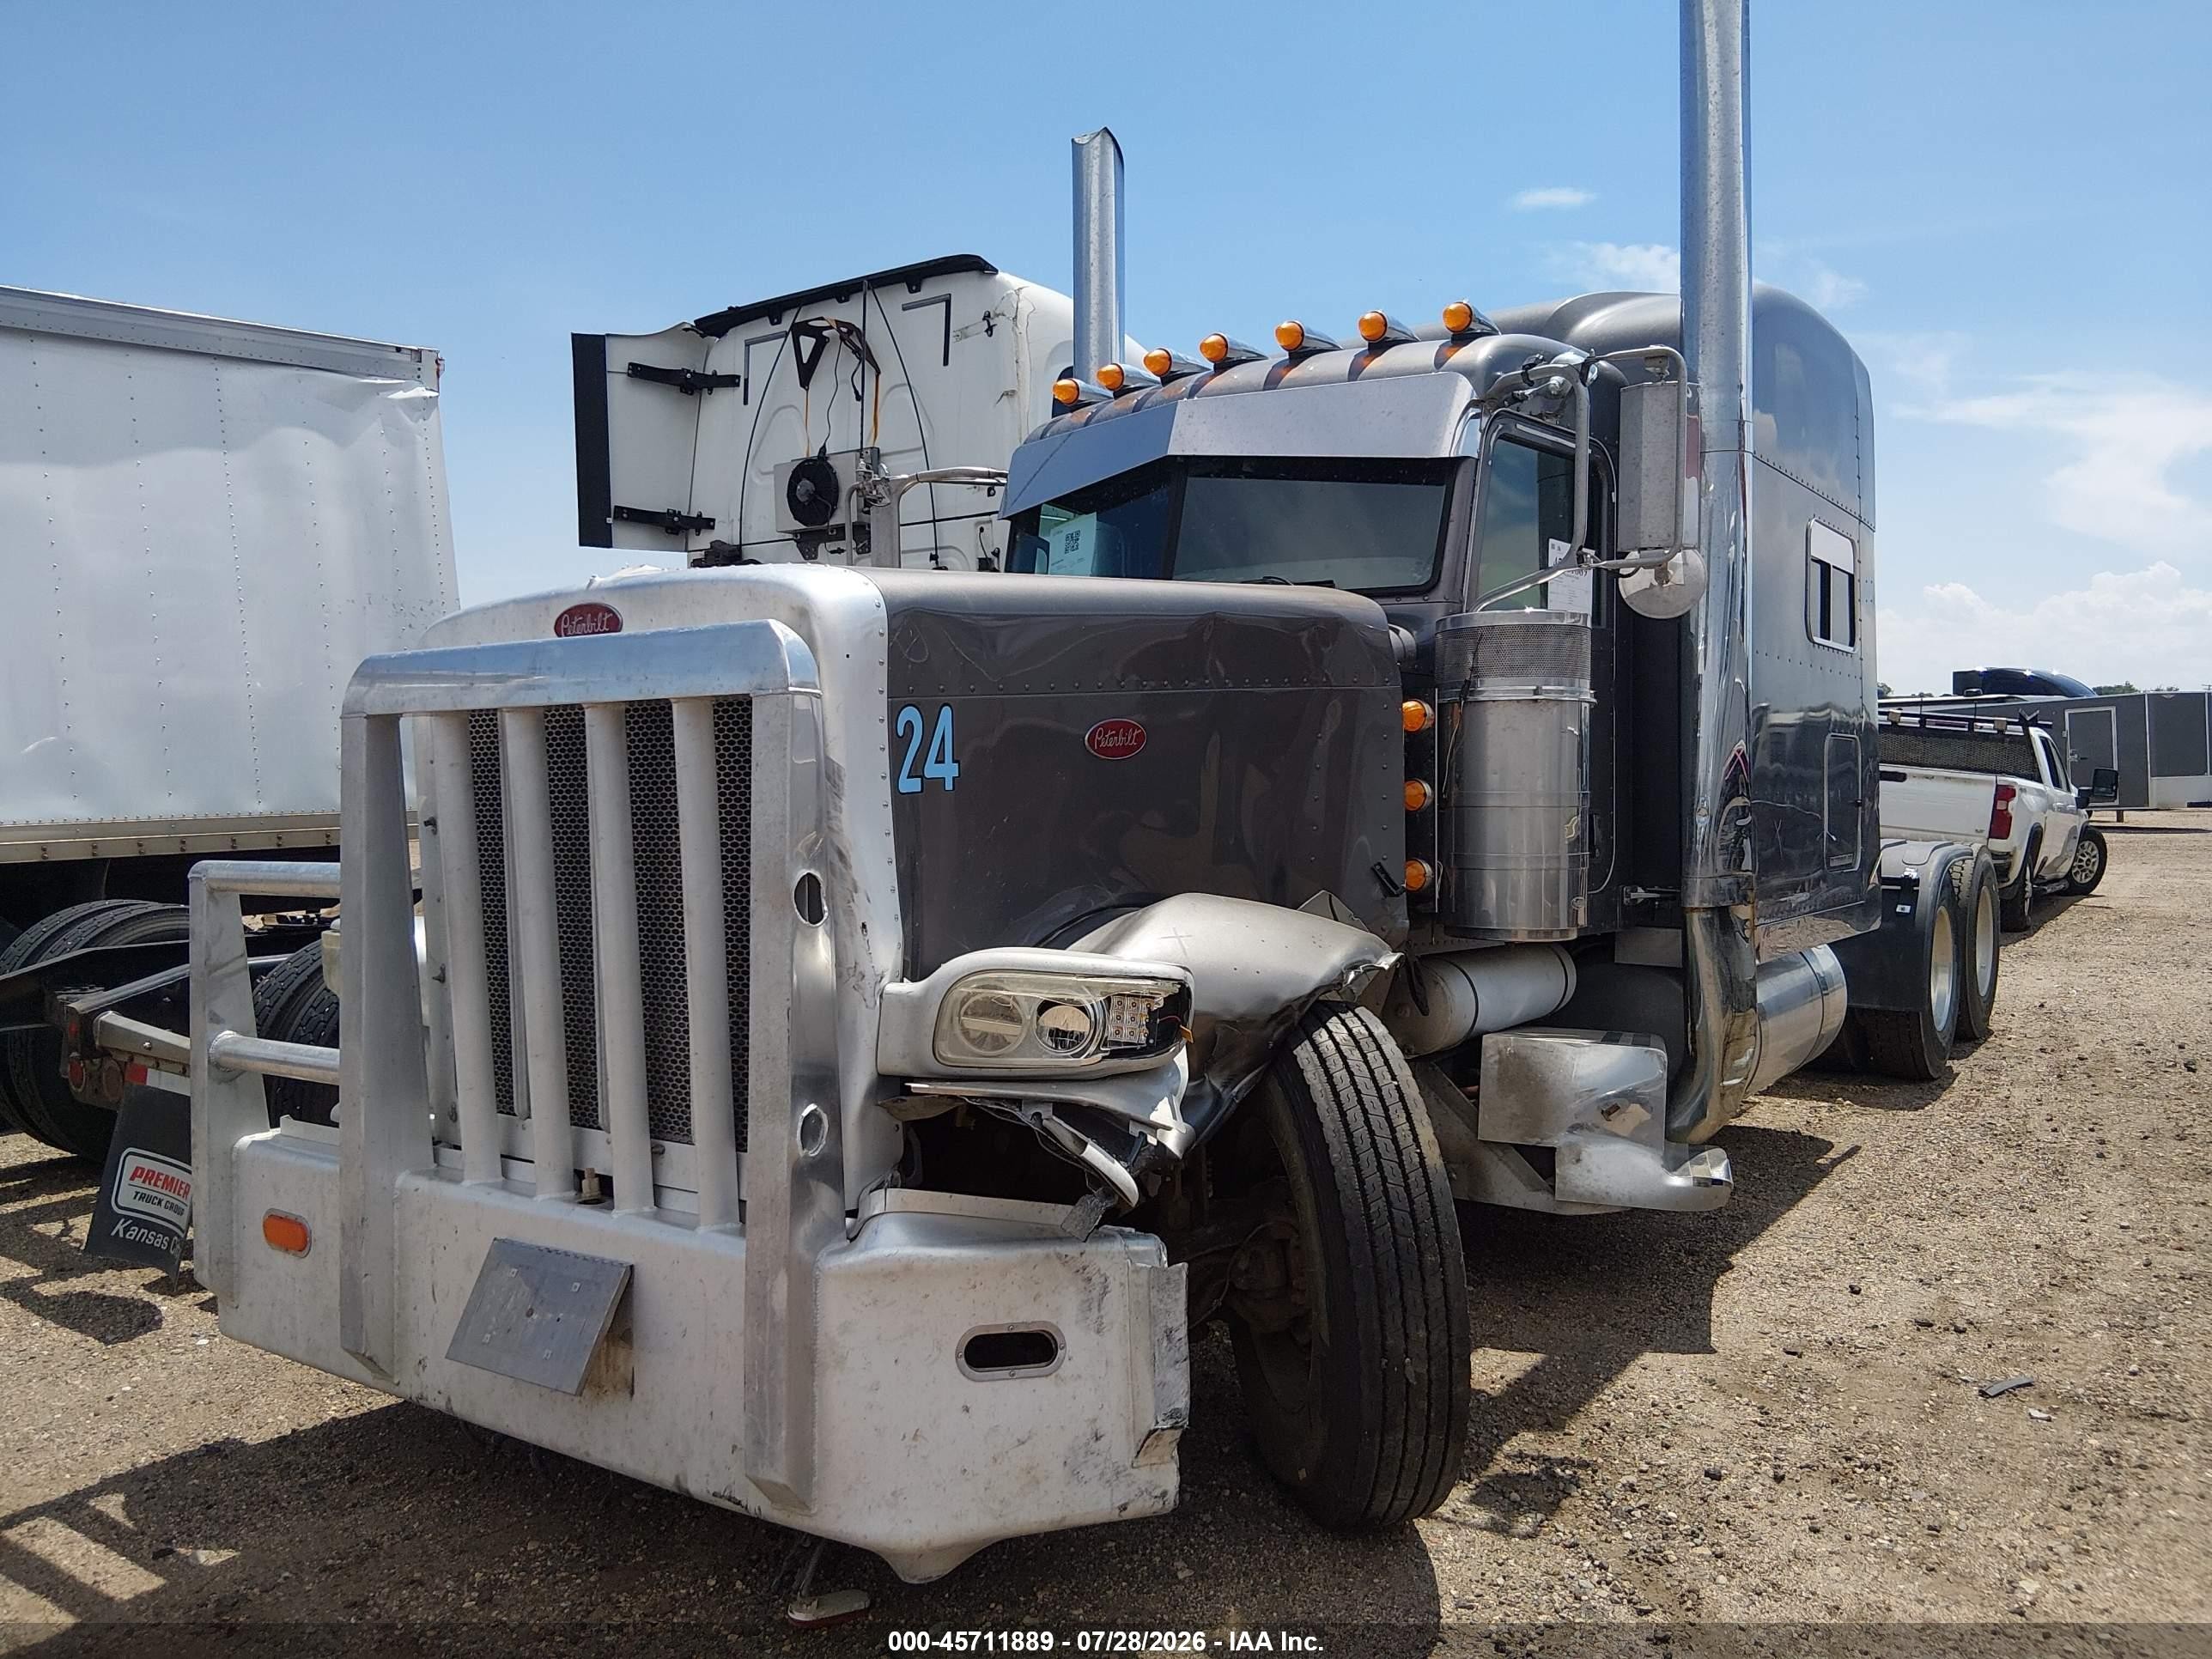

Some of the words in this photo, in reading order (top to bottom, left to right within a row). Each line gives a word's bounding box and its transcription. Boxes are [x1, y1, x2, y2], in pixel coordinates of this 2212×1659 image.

[560, 612, 613, 637] Peterbilt
[896, 703, 961, 794] 24
[1094, 726, 1142, 750] Peterbilt
[129, 1166, 191, 1200] PREMIER
[133, 1191, 164, 1207] TRUCK
[111, 1218, 170, 1250] Kansas
